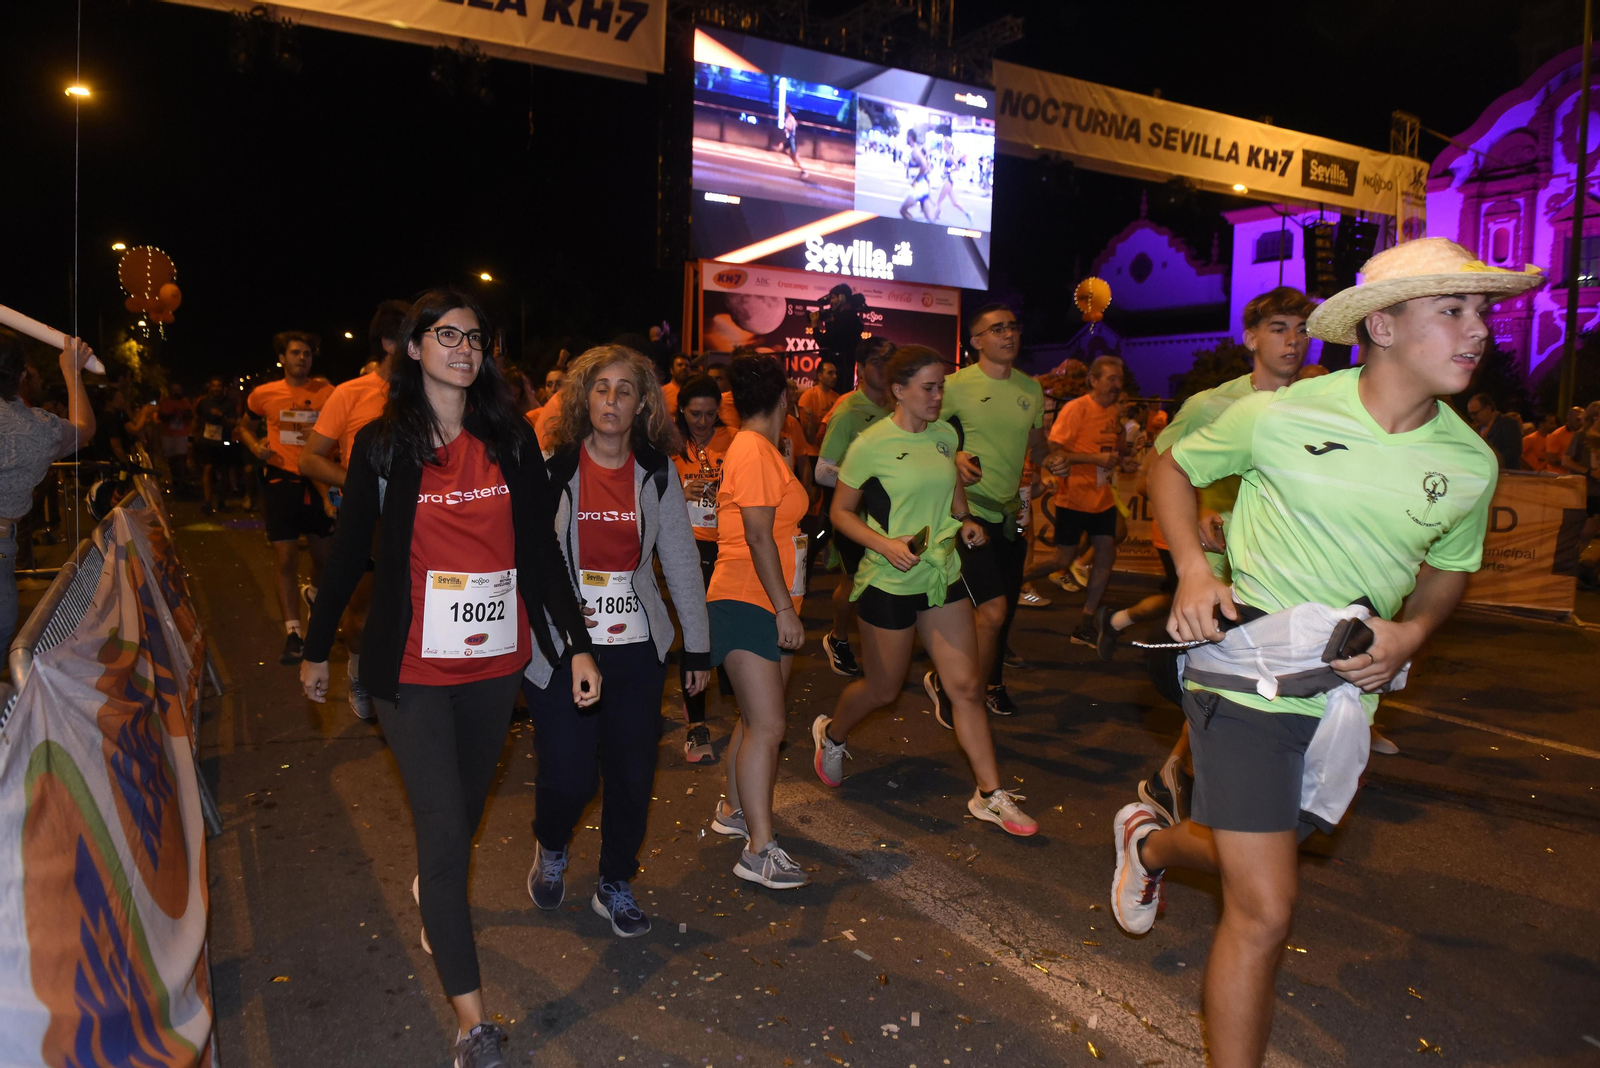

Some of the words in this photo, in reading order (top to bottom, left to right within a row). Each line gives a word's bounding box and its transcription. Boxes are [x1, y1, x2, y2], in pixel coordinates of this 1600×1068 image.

[1001, 88, 1142, 144] NOCTURNA
[1148, 121, 1240, 166] SEVILLA
[620, 511, 637, 521] st
[450, 600, 505, 622] 18022
[595, 596, 639, 614] 18053
